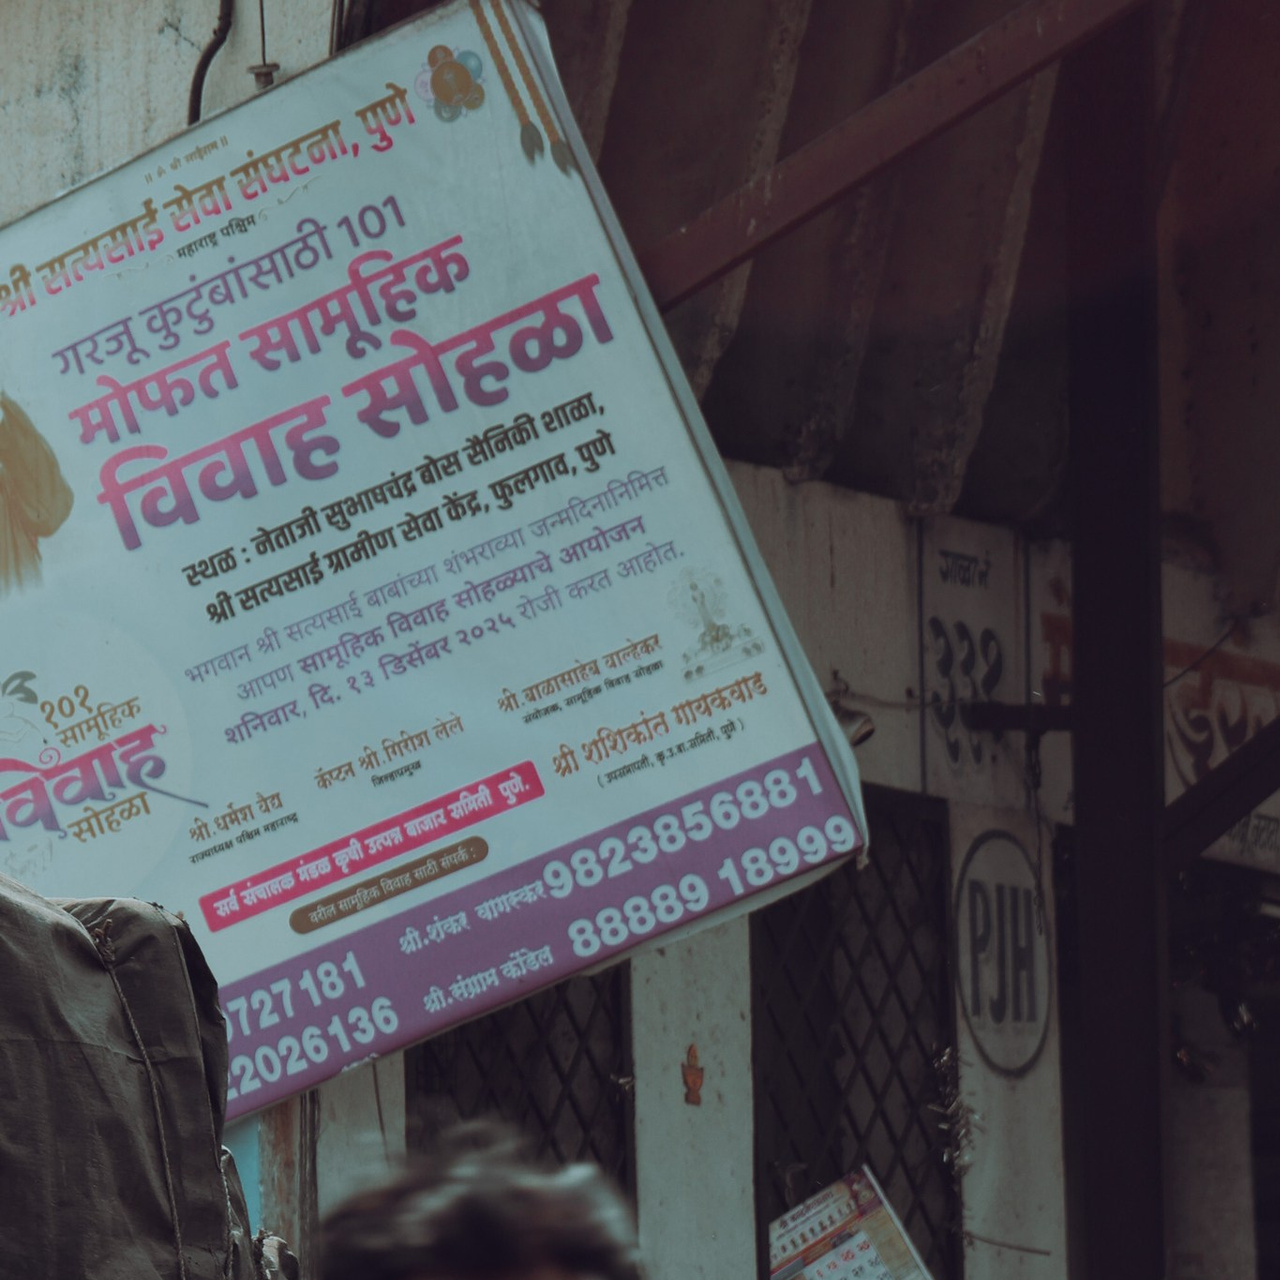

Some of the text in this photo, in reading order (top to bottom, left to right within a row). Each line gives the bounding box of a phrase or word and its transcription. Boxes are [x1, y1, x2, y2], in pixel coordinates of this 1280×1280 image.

[0, 82, 415, 316] श्री सत्यसाई सेवा संघटना, पुणे
[51, 195, 406, 374] गरजू कुटुंबांसाठी 101
[68, 234, 470, 444] मोफत सामूहिक
[97, 273, 614, 551] विवाह सोहळा
[181, 546, 237, 586] स्थळ
[250, 505, 322, 555] नेताजी
[320, 470, 417, 531] सुभाषचंद्र
[415, 450, 463, 485] बोस
[461, 413, 539, 465] सैनिकी
[540, 391, 604, 433] शाळा,
[184, 643, 252, 682] भगवान
[256, 626, 281, 654] श्री
[283, 589, 363, 642] सत्यसाई
[528, 465, 669, 537] जन्मदिनानिमित्त
[206, 590, 235, 623] श्री
[234, 551, 324, 611] सत्यसाई
[322, 526, 397, 573] ग्रामीण
[397, 506, 444, 542] सेवा
[487, 452, 577, 510] फुलगाव,
[574, 429, 615, 473] पुणे
[224, 540, 685, 744] शनिवार, दि. १३ डिसेंबर २०२५ रोजी करत आहोत.
[237, 663, 294, 700] आपण
[296, 625, 385, 674] सामूहिक
[386, 598, 450, 638] विवाह
[559, 515, 646, 564] आयोजन
[40, 685, 90, 729] १०१
[56, 696, 141, 748] सामूहिक
[552, 743, 579, 777] श्री
[67, 791, 151, 843] सोहळा
[543, 757, 822, 898] 9823856881
[568, 873, 709, 956] 88889
[717, 815, 855, 895] 18999
[222, 951, 365, 1042] 727181
[967, 878, 1038, 1025] PJH
